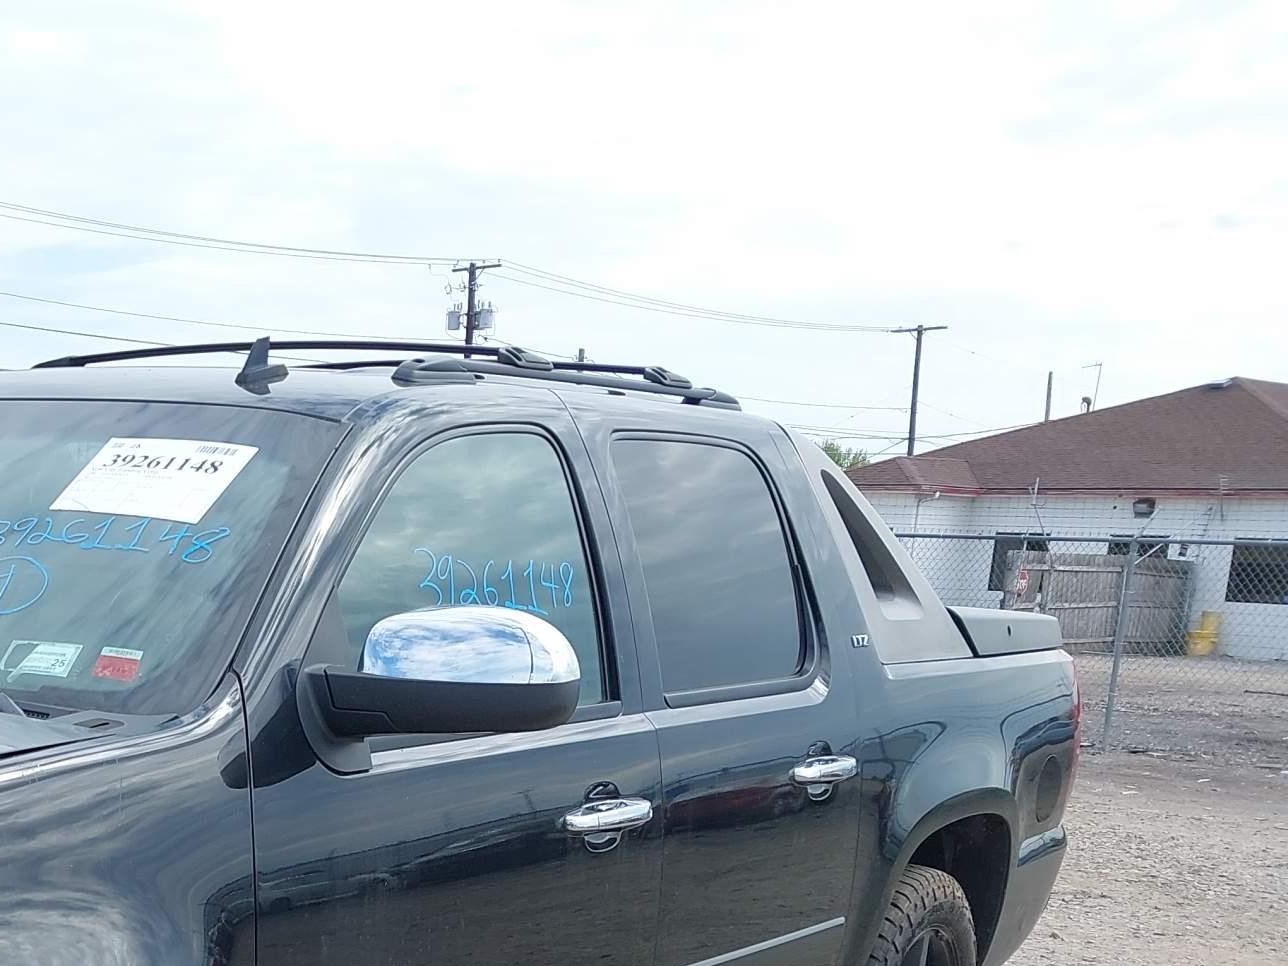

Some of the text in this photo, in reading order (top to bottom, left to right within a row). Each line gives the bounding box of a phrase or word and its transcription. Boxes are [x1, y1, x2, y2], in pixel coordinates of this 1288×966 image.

[102, 453, 224, 474] 39261148
[414, 547, 574, 616] 39261148
[851, 634, 870, 648] LTZ
[51, 658, 67, 668] 25
